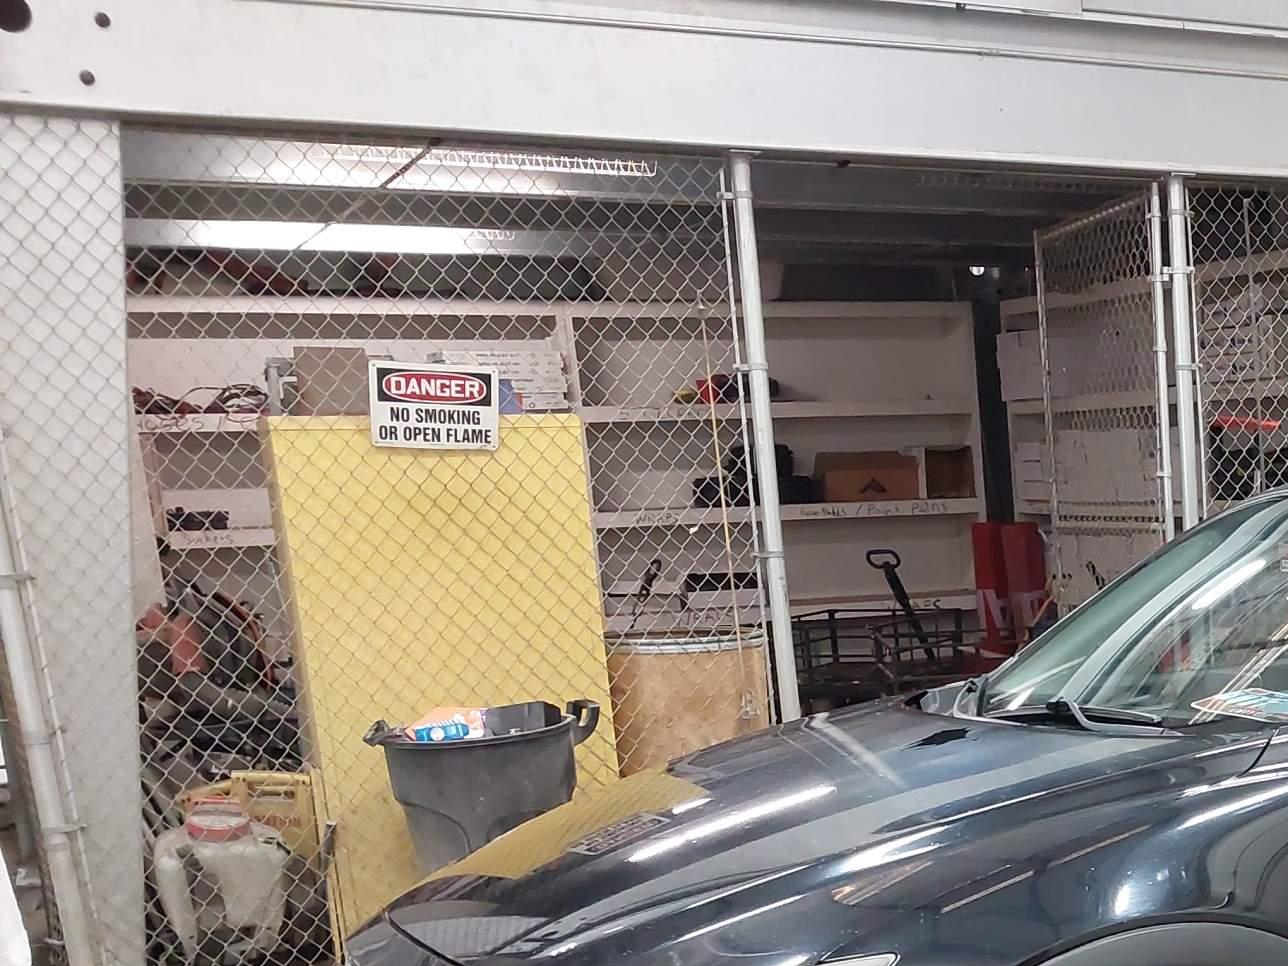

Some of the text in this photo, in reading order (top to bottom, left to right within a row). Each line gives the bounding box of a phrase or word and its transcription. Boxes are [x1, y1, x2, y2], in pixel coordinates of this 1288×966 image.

[390, 376, 480, 398] DANGER
[389, 406, 481, 425] NO SMOKING
[379, 425, 492, 444] OR OPEN FLAME
